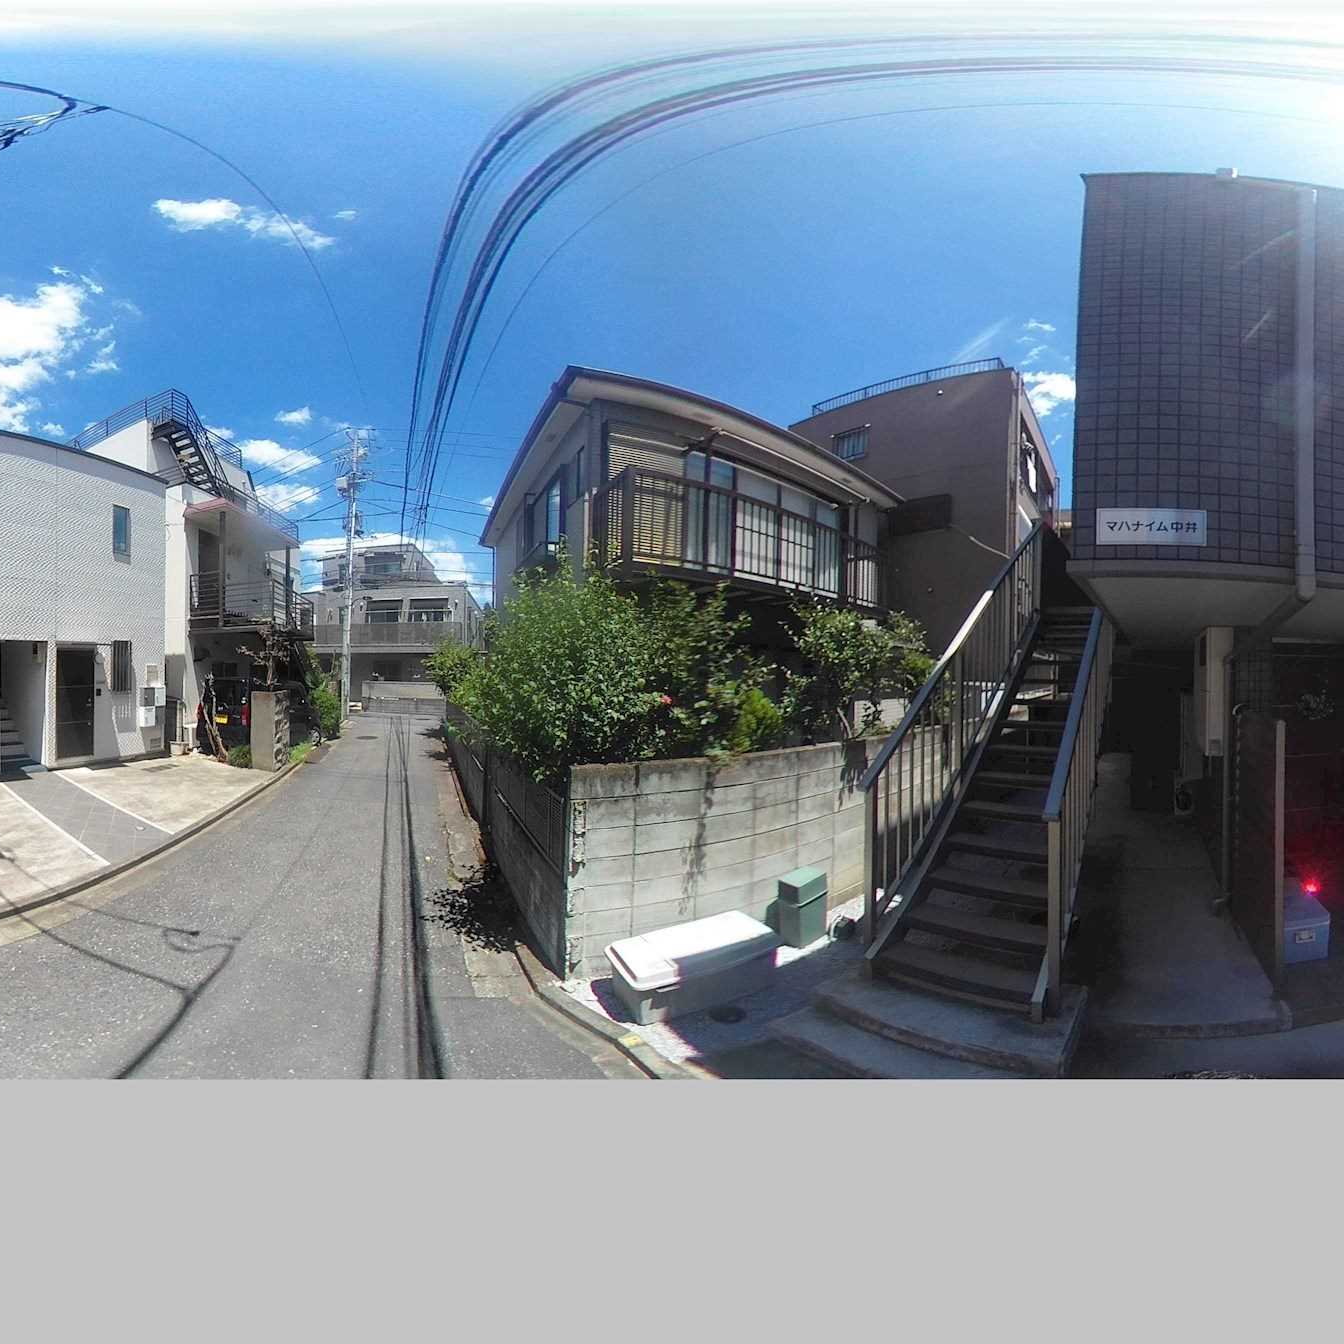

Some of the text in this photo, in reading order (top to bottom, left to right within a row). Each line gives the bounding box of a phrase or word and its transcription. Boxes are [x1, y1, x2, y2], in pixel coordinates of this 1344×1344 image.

[1105, 520, 1198, 533] マハナイム中井
